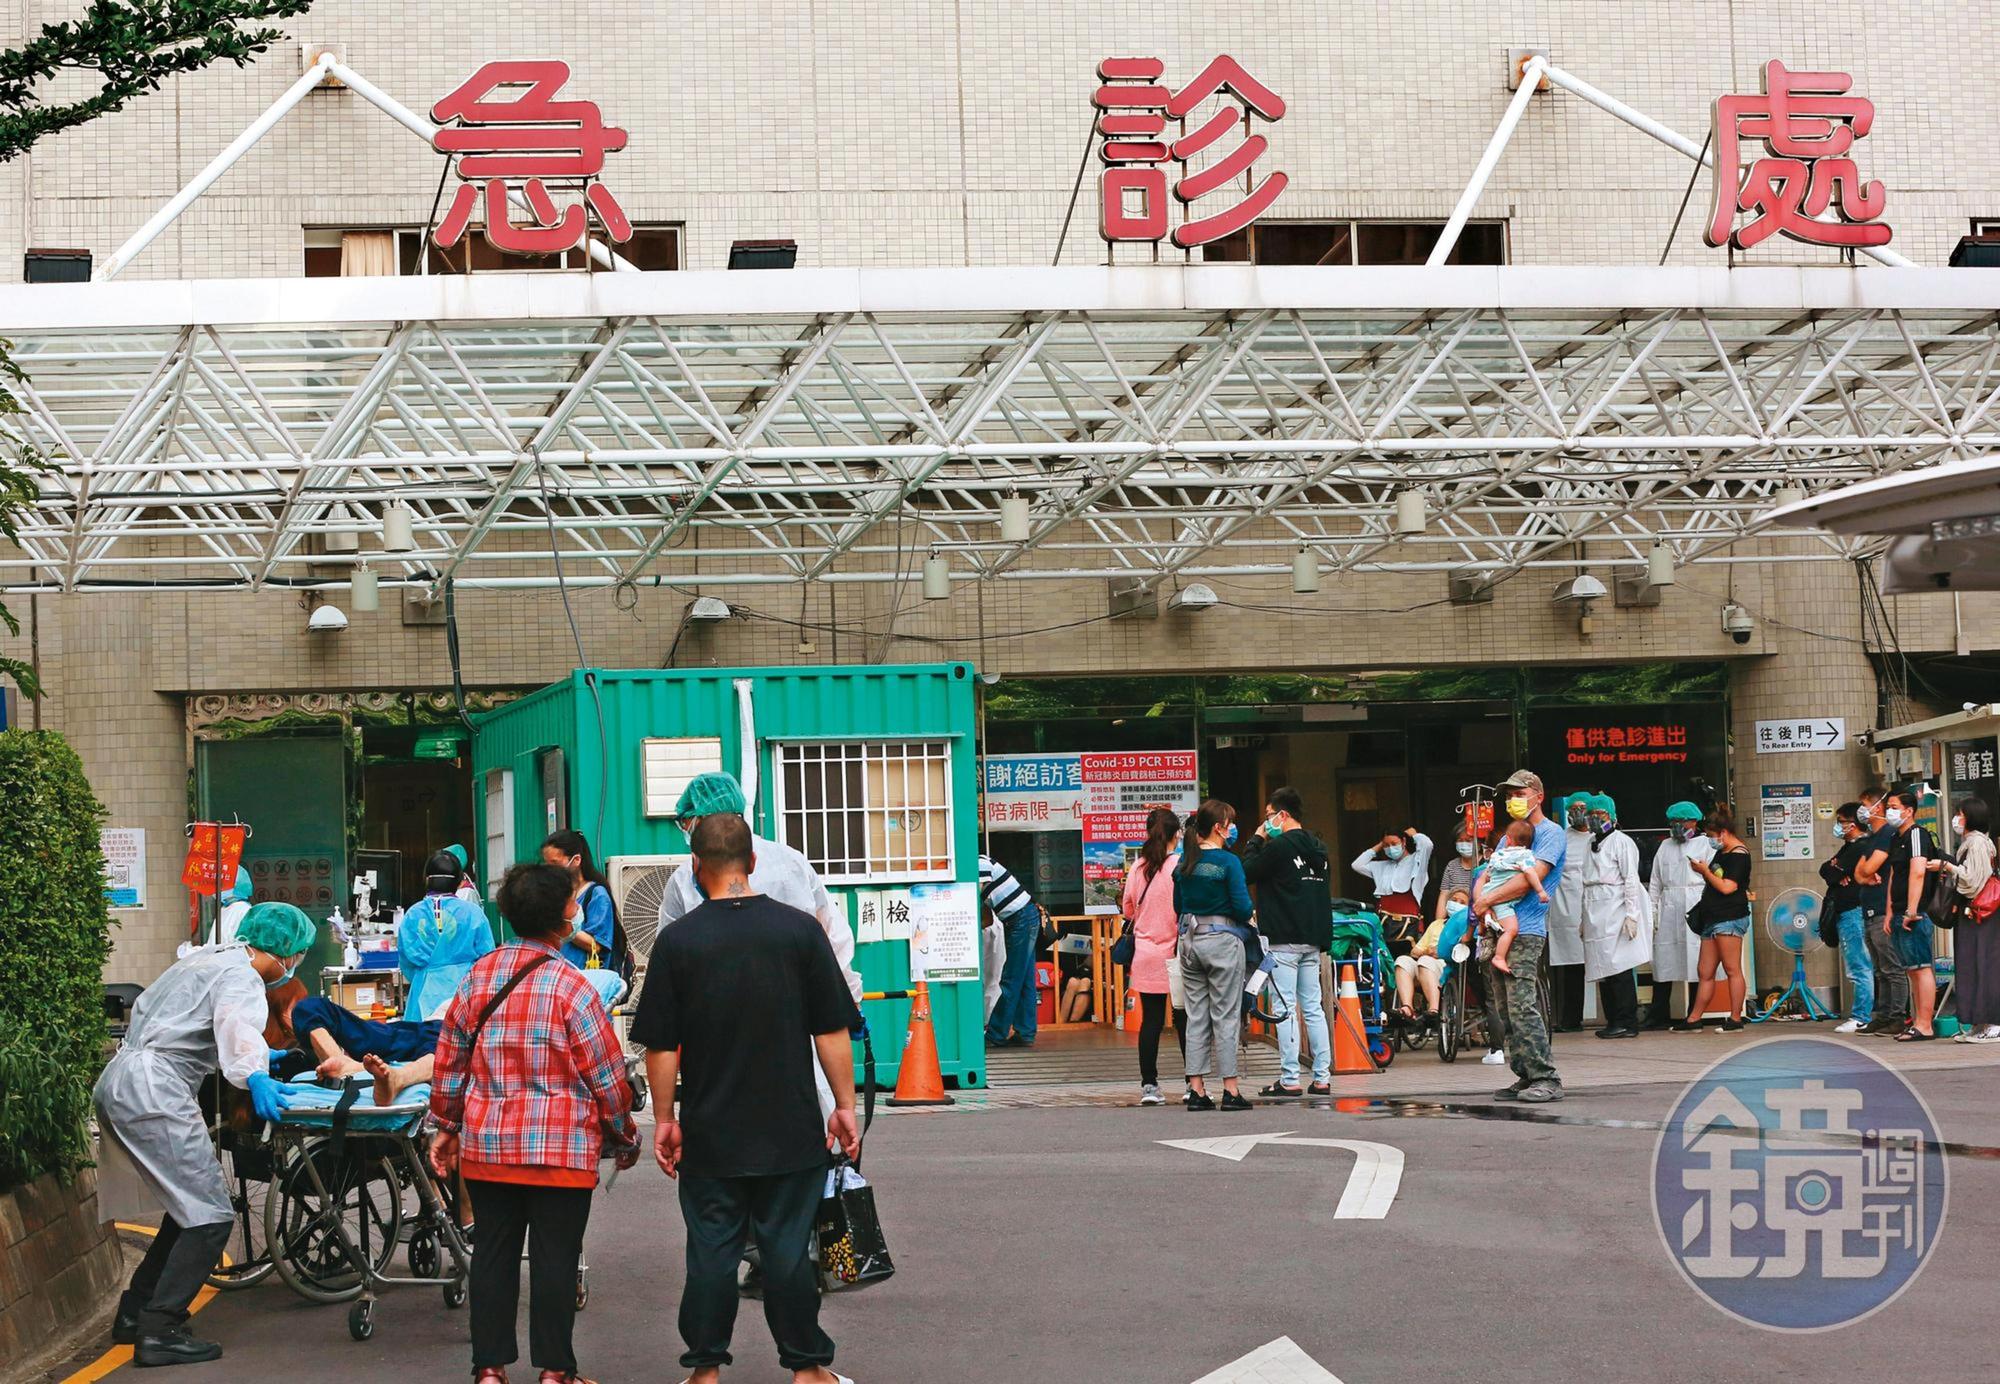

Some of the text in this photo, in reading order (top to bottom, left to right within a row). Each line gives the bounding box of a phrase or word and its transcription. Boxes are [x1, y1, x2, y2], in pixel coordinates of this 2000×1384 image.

[1760, 725, 1812, 741] 往後門
[1791, 741, 1812, 749] Entry
[1084, 755, 1193, 768] Covid-19 PCR TEST
[1567, 751, 1687, 764] Only for Emergency
[1953, 750, 1995, 781] 警衛室
